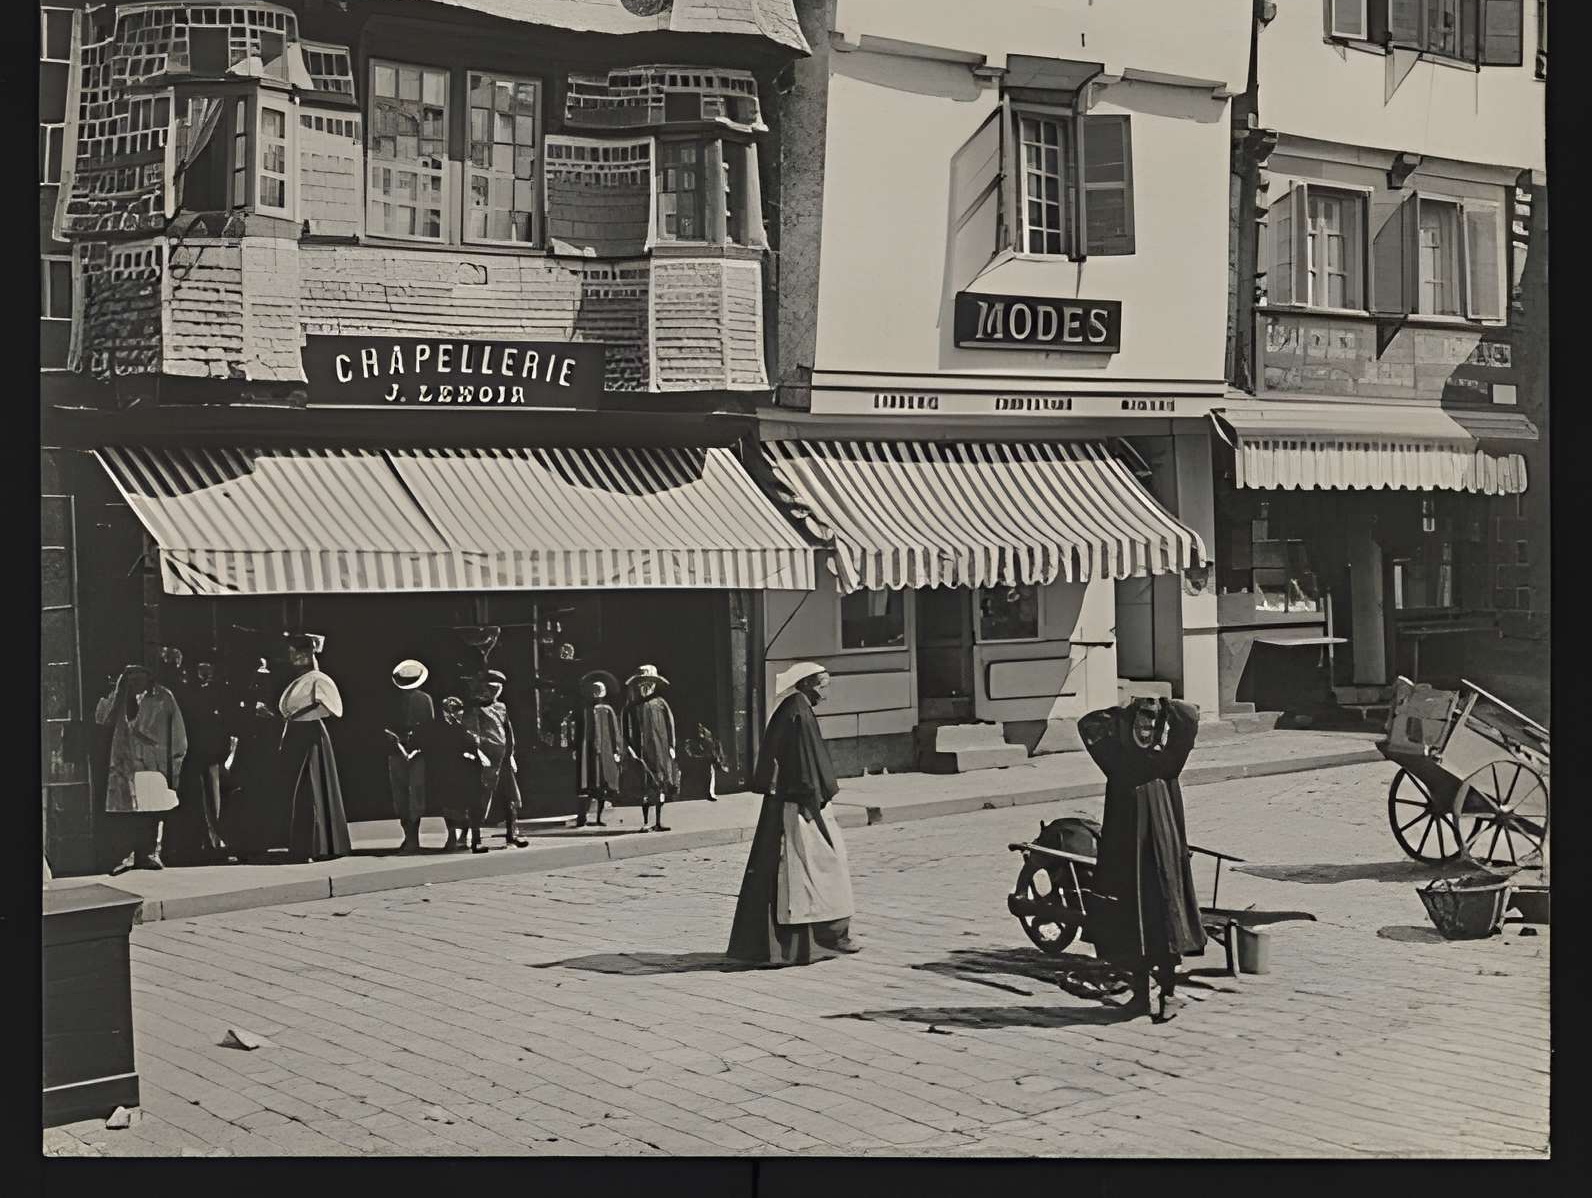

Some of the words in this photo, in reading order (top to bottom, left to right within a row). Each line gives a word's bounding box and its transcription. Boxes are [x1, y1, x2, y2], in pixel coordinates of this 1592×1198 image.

[975, 300, 1109, 343] MODES
[336, 345, 576, 387] CHAPELLERIE
[385, 384, 406, 403] J.
